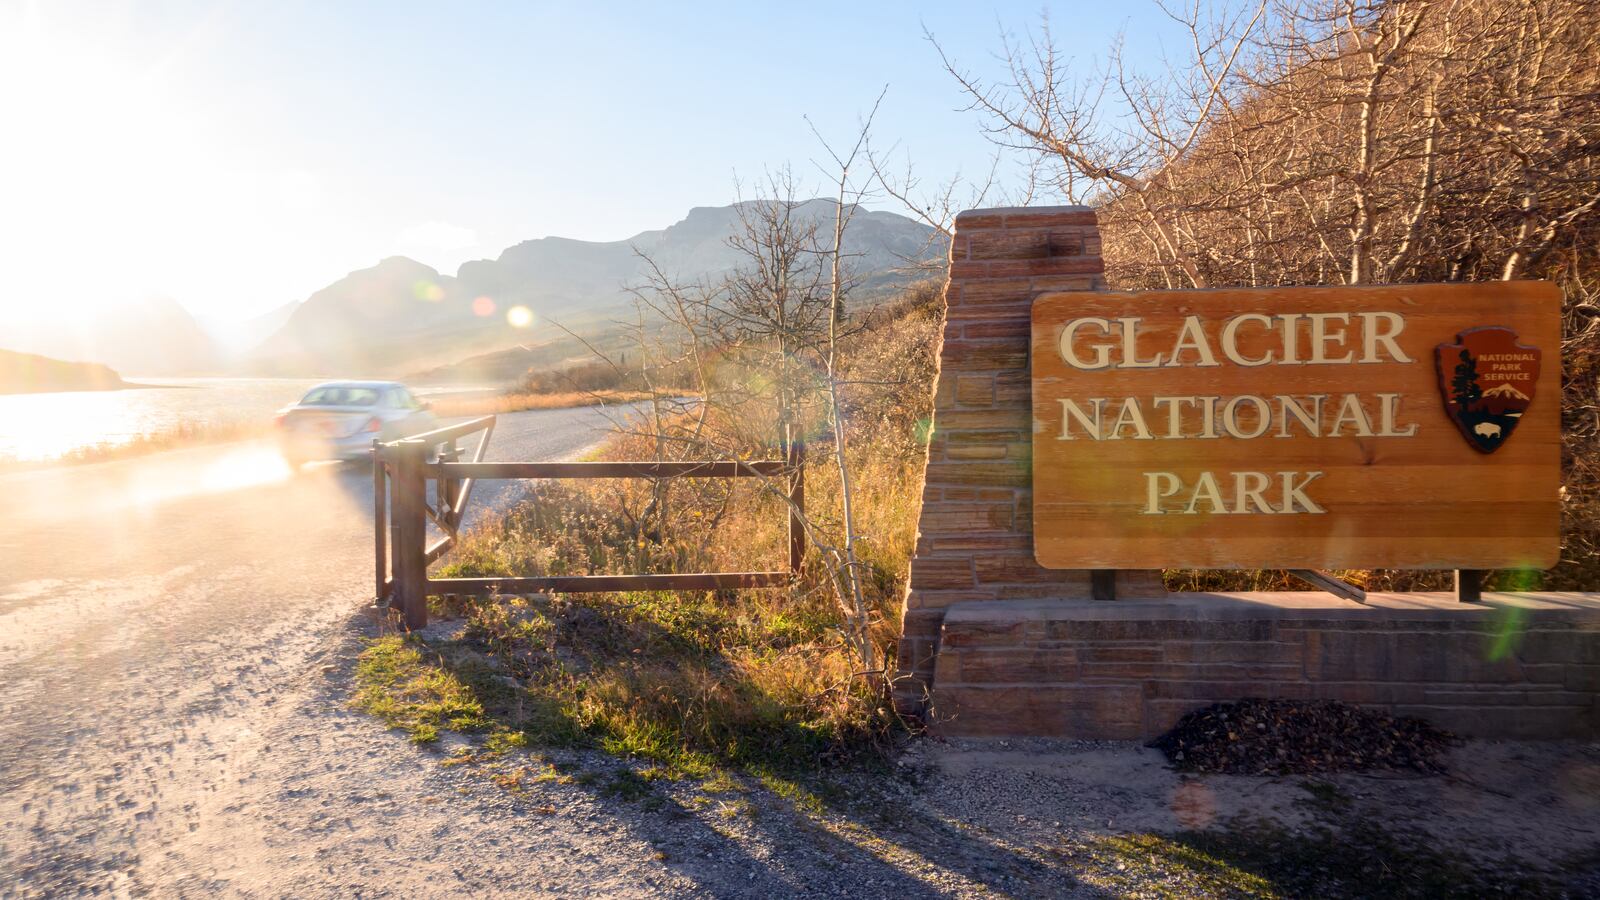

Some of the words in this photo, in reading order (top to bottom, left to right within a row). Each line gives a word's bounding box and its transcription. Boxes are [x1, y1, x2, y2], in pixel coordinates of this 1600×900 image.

[1058, 311, 1413, 369] GLACIER
[1479, 353, 1536, 362] NATIONAL
[1492, 363, 1522, 371] PARK
[1484, 372, 1531, 381] SERVICE
[1056, 393, 1419, 441] NATIONAL
[1142, 471, 1327, 515] PARK
